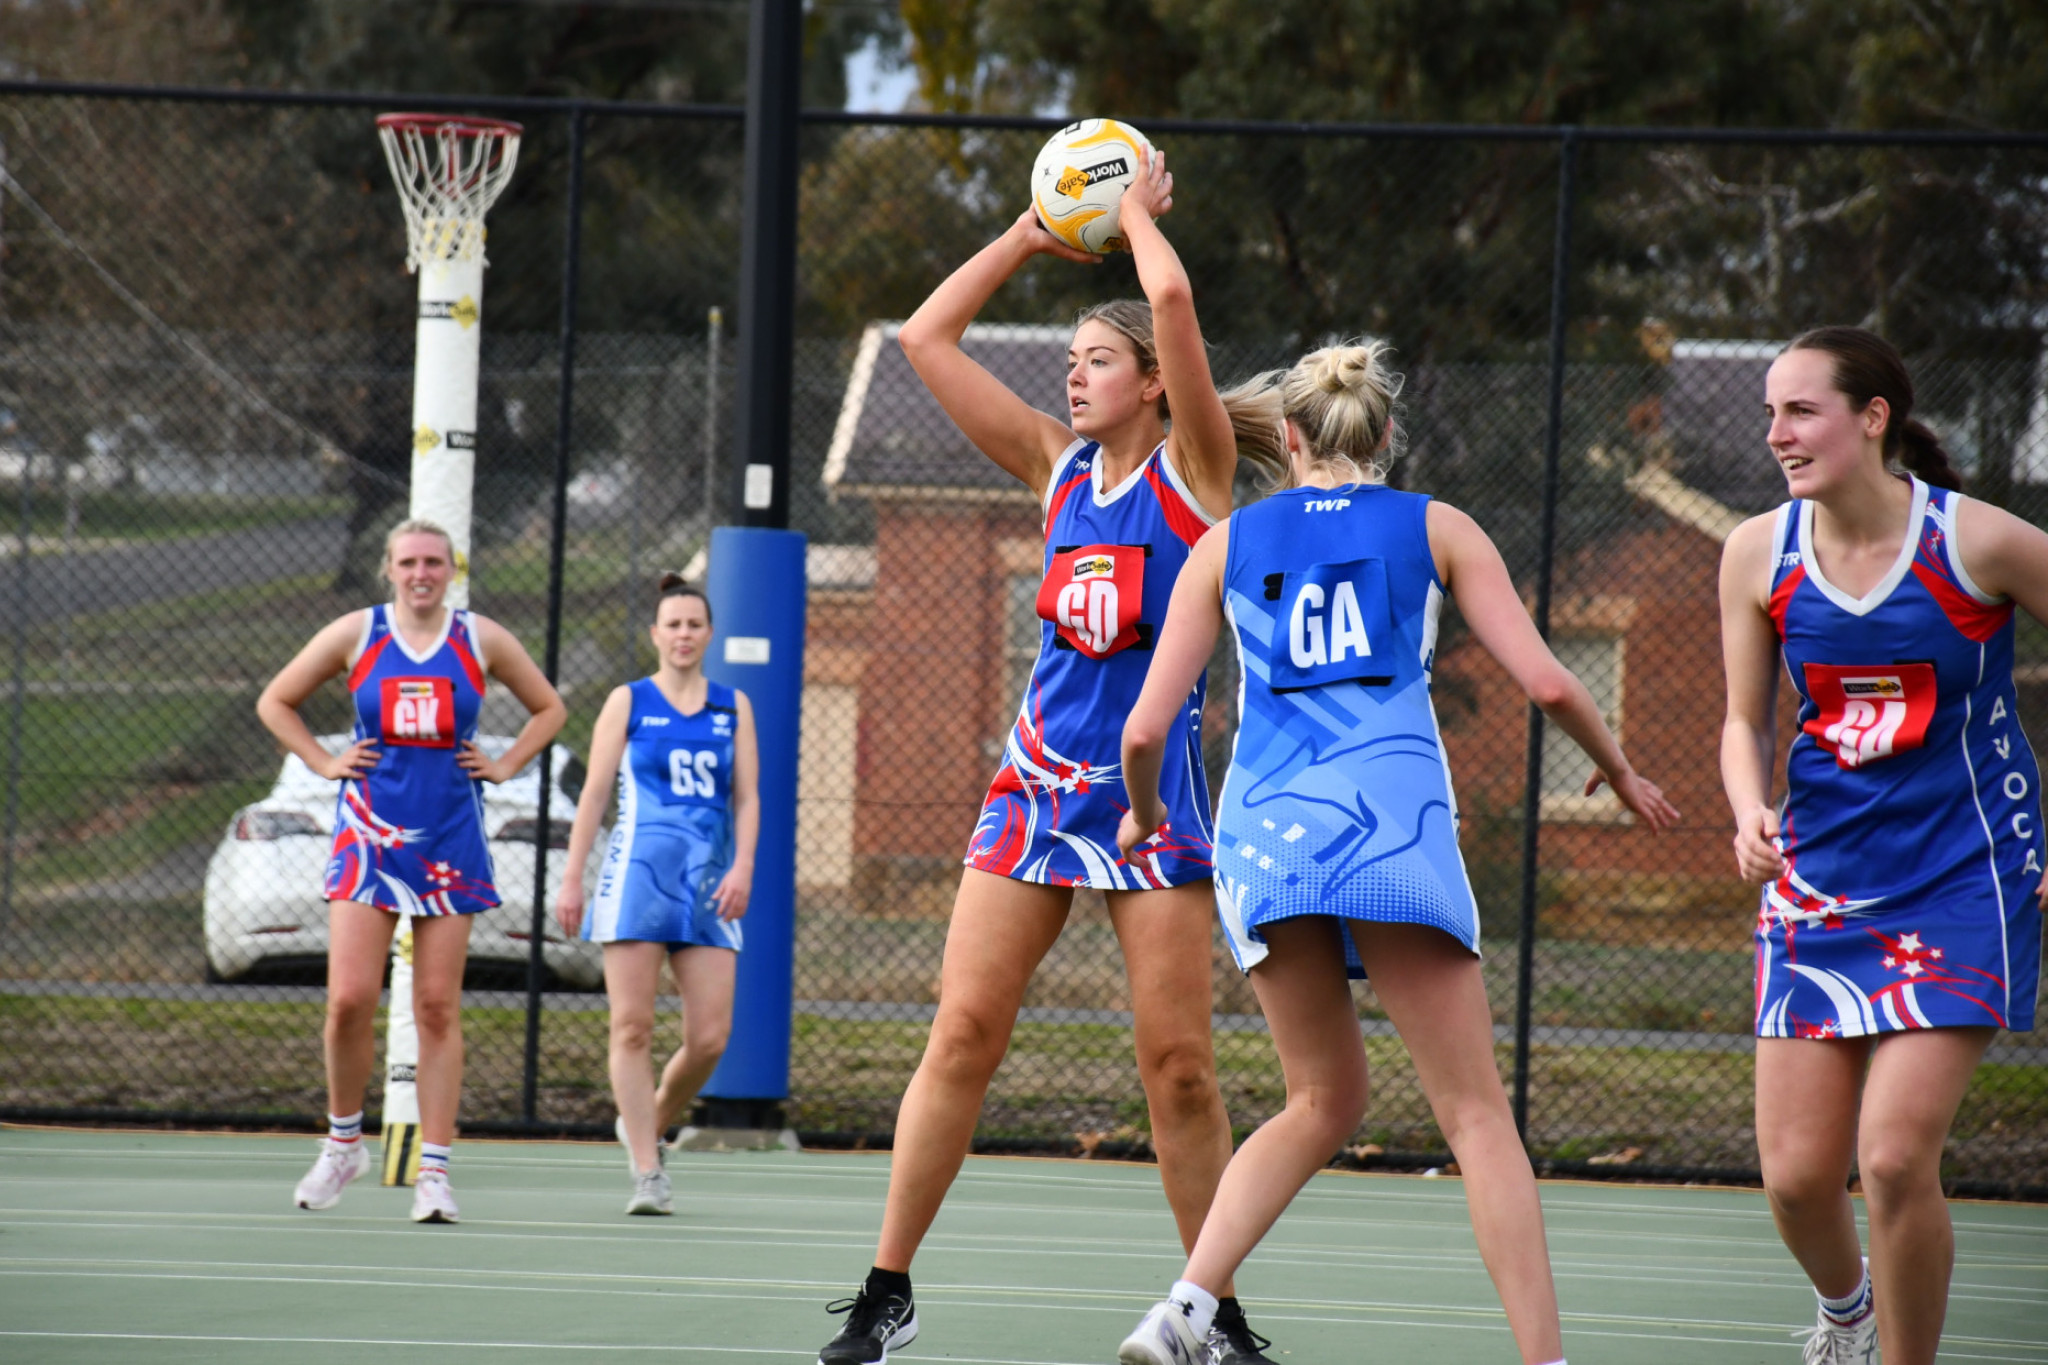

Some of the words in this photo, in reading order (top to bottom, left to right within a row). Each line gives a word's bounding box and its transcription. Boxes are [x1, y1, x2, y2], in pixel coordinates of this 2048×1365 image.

[1303, 499, 1351, 513] TWP
[1056, 580, 1118, 653] GD
[1289, 580, 1372, 668] GA
[393, 699, 441, 740] GK
[669, 749, 717, 798] GS
[1988, 696, 2042, 875] AVOCA
